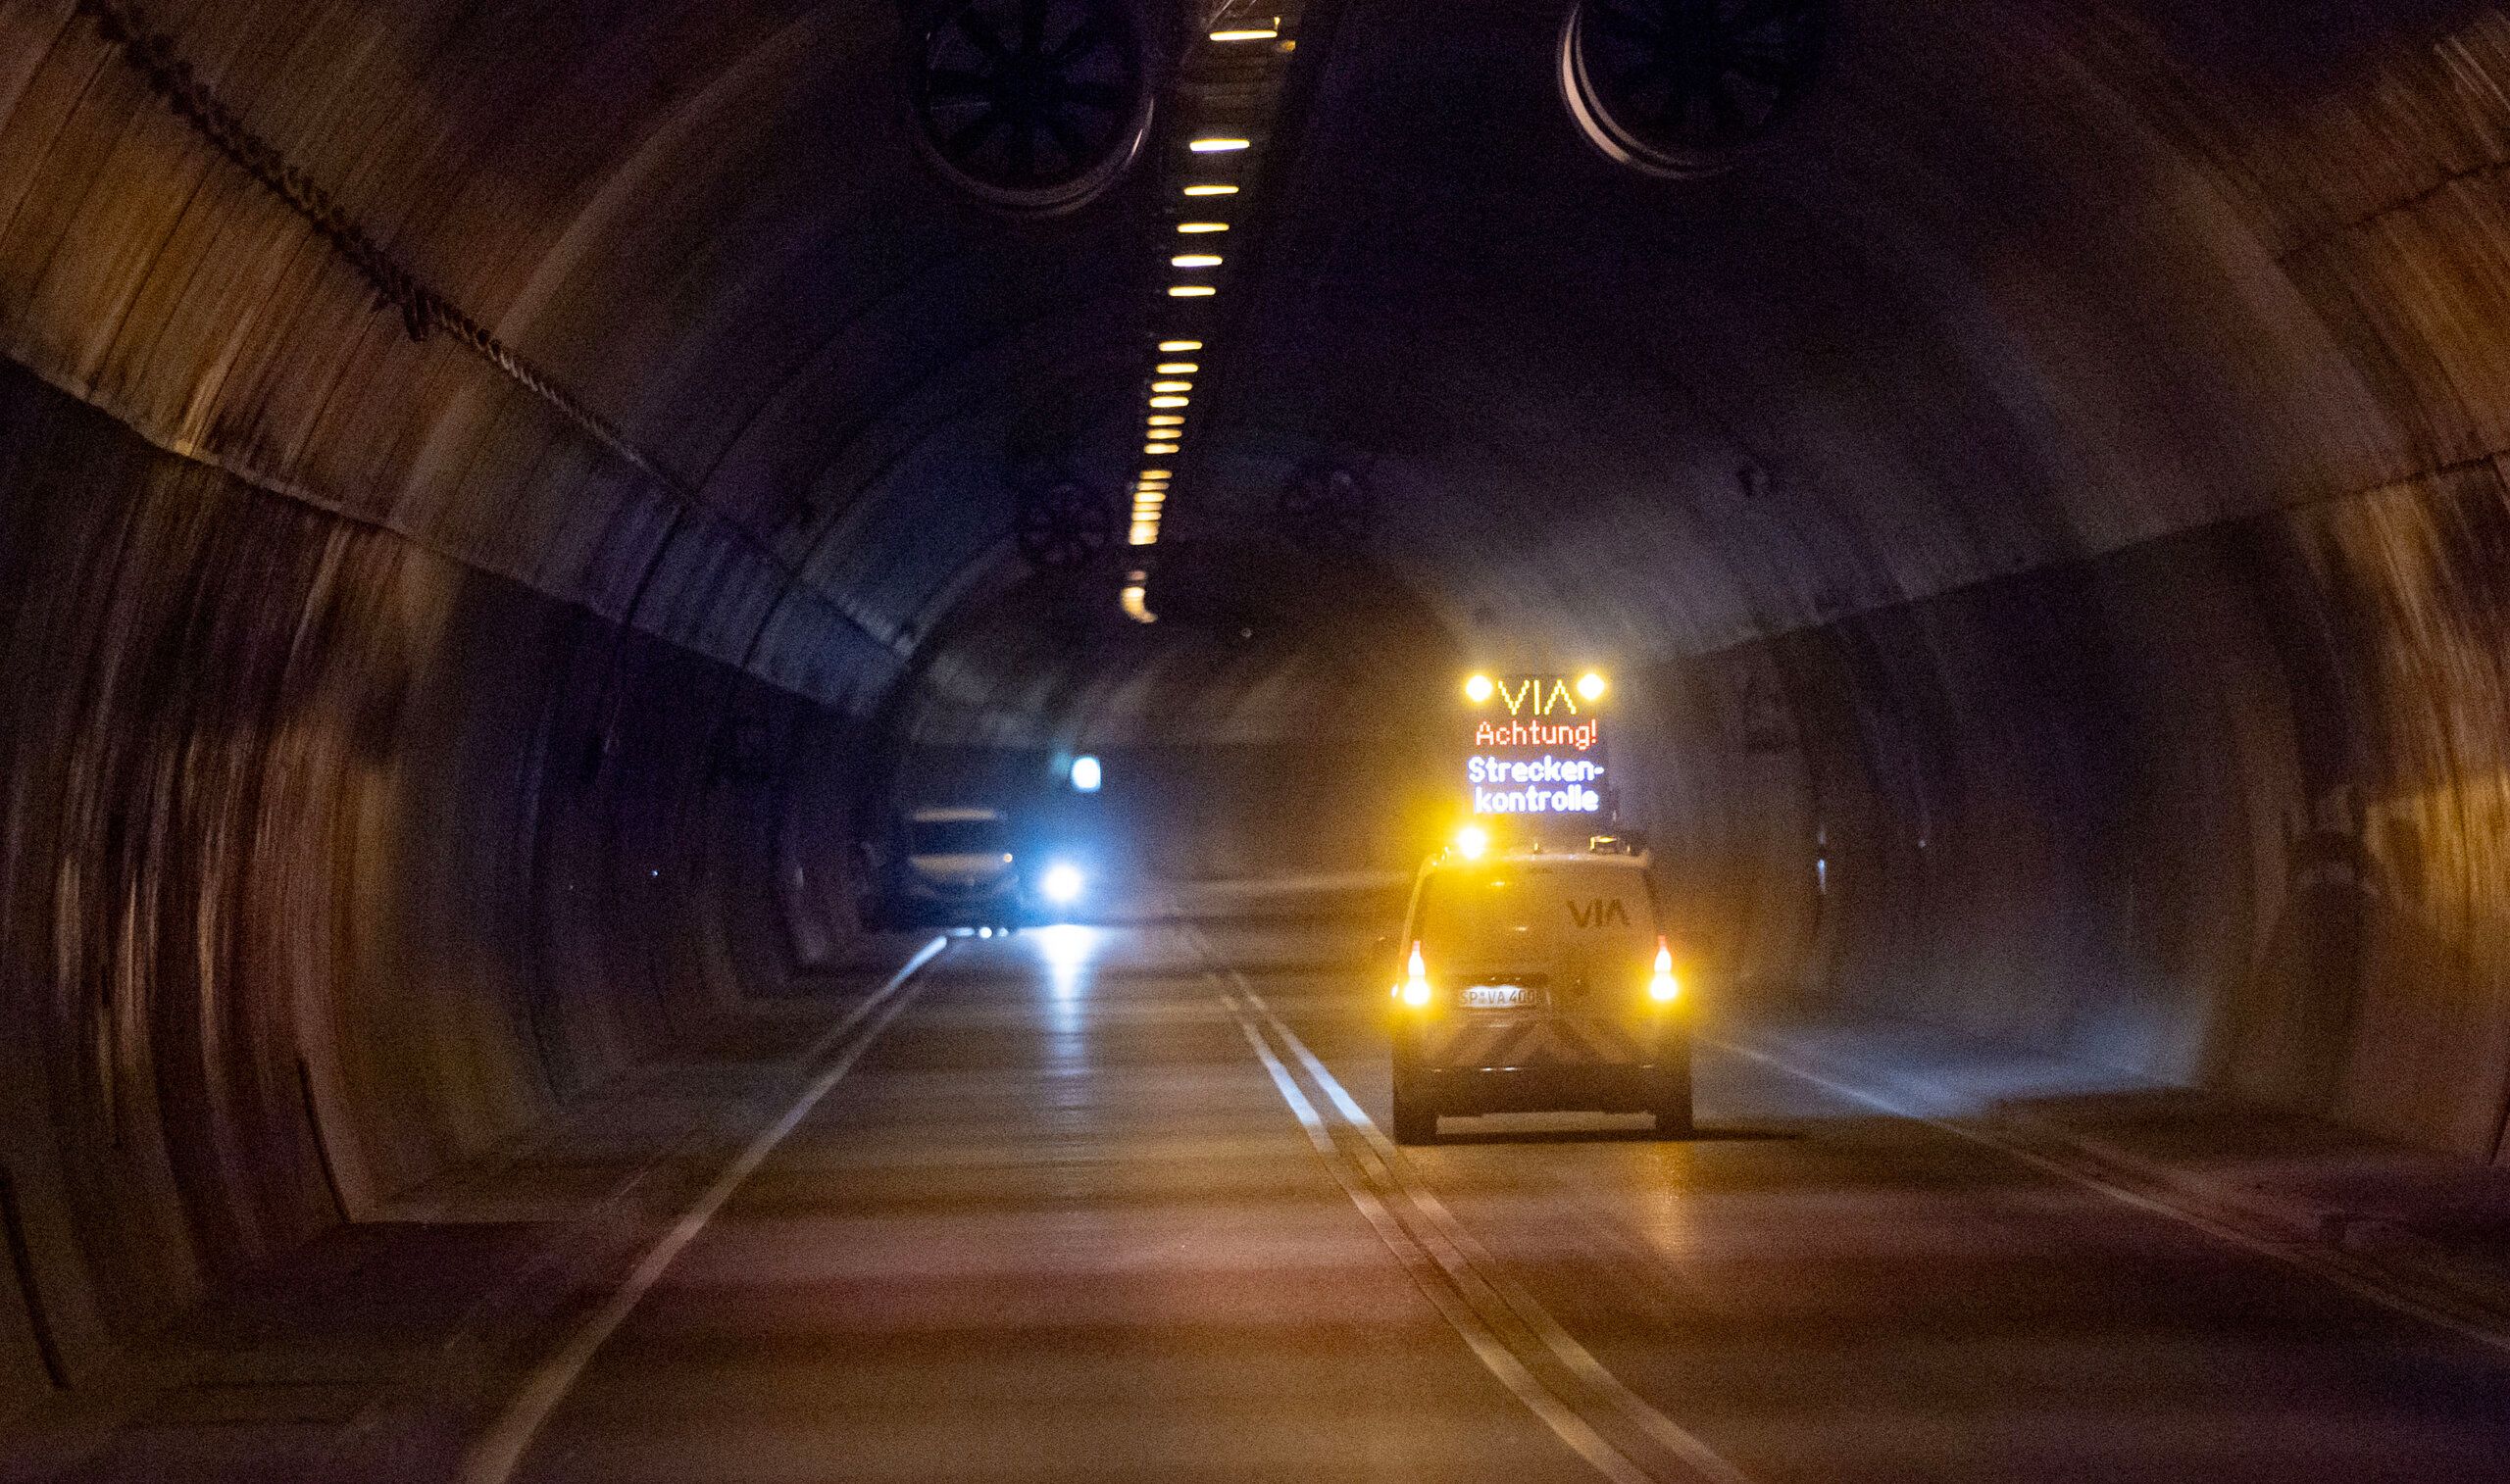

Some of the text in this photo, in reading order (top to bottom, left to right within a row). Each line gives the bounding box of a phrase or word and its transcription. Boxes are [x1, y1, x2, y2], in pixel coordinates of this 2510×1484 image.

[1497, 679, 1577, 716] VIA
[1476, 718, 1598, 751] Achtung!
[1468, 755, 1605, 783] Strecken-
[1474, 784, 1600, 813] kontrolle
[1566, 897, 1631, 927] VIA
